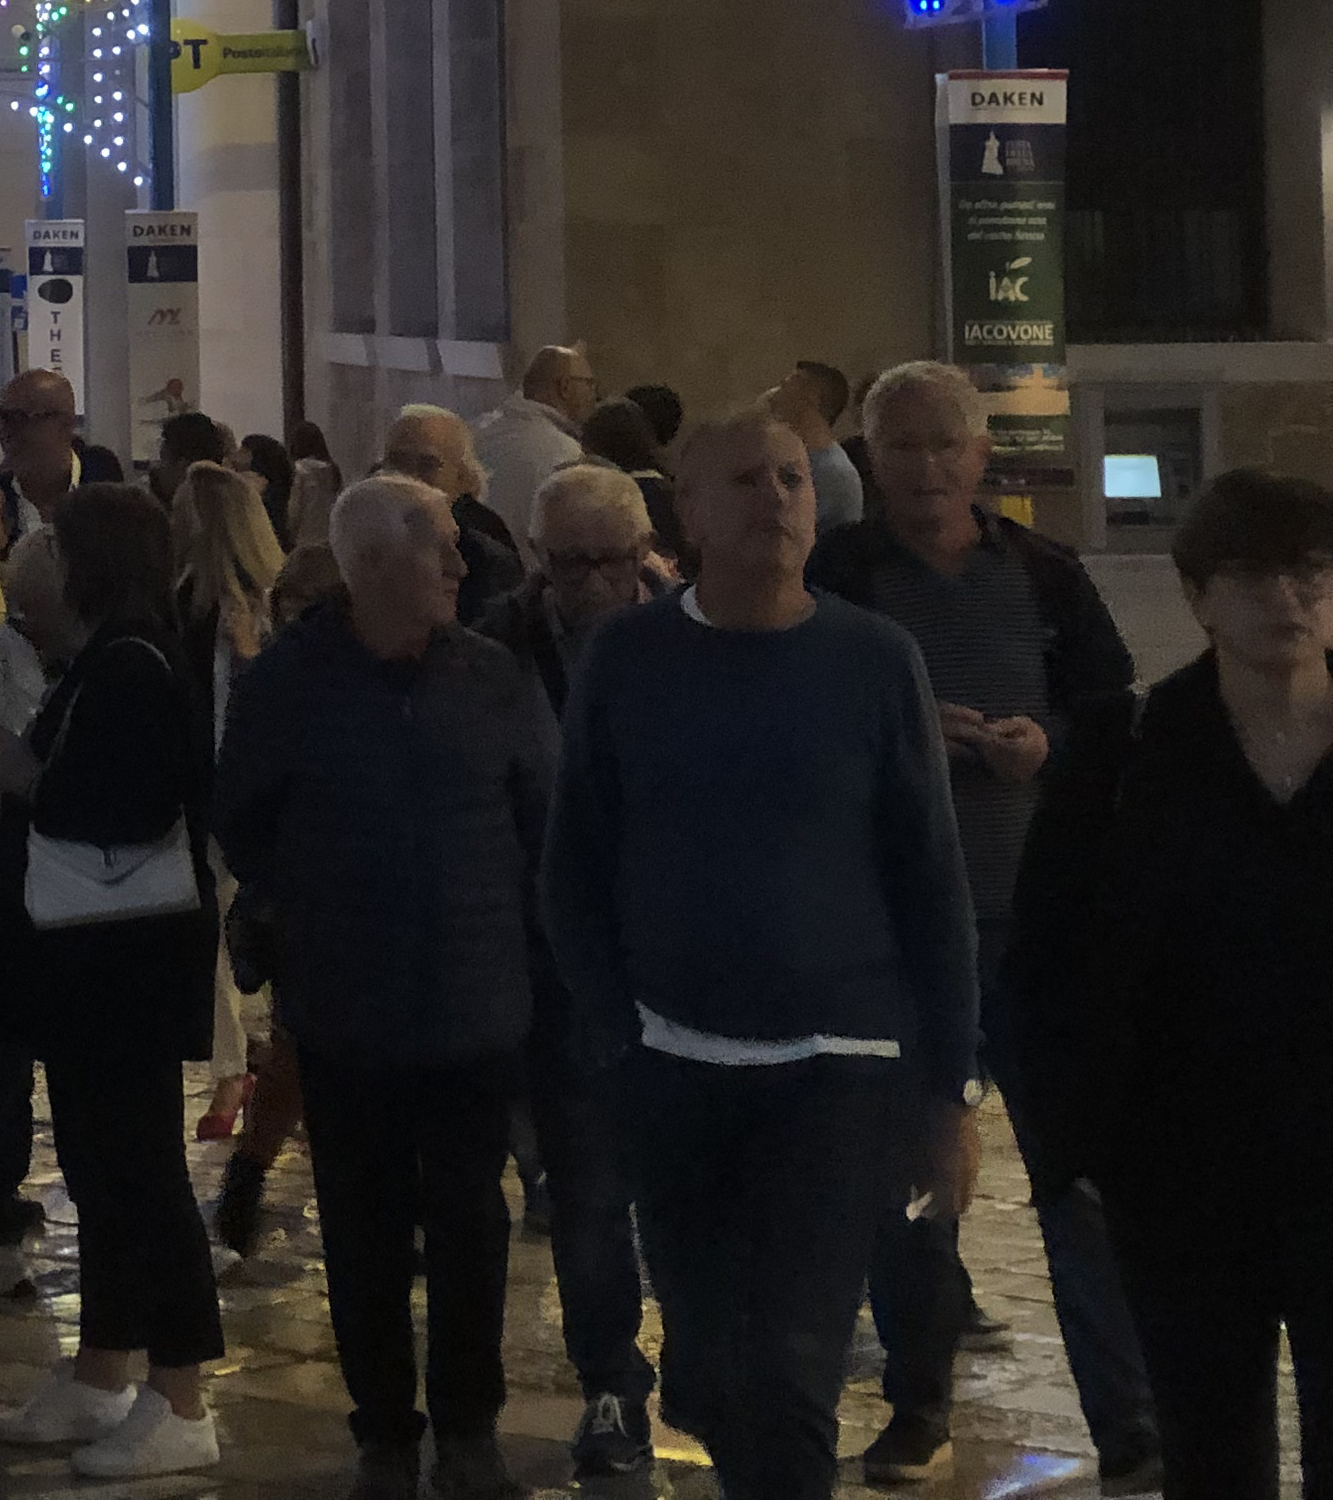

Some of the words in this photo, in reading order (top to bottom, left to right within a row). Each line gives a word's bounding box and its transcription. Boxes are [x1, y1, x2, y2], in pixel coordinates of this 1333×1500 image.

[970, 91, 1044, 107] DAKEN
[34, 229, 79, 240] DAKEN
[133, 224, 192, 238] DAKEN
[964, 323, 1054, 341] IACOVONE
